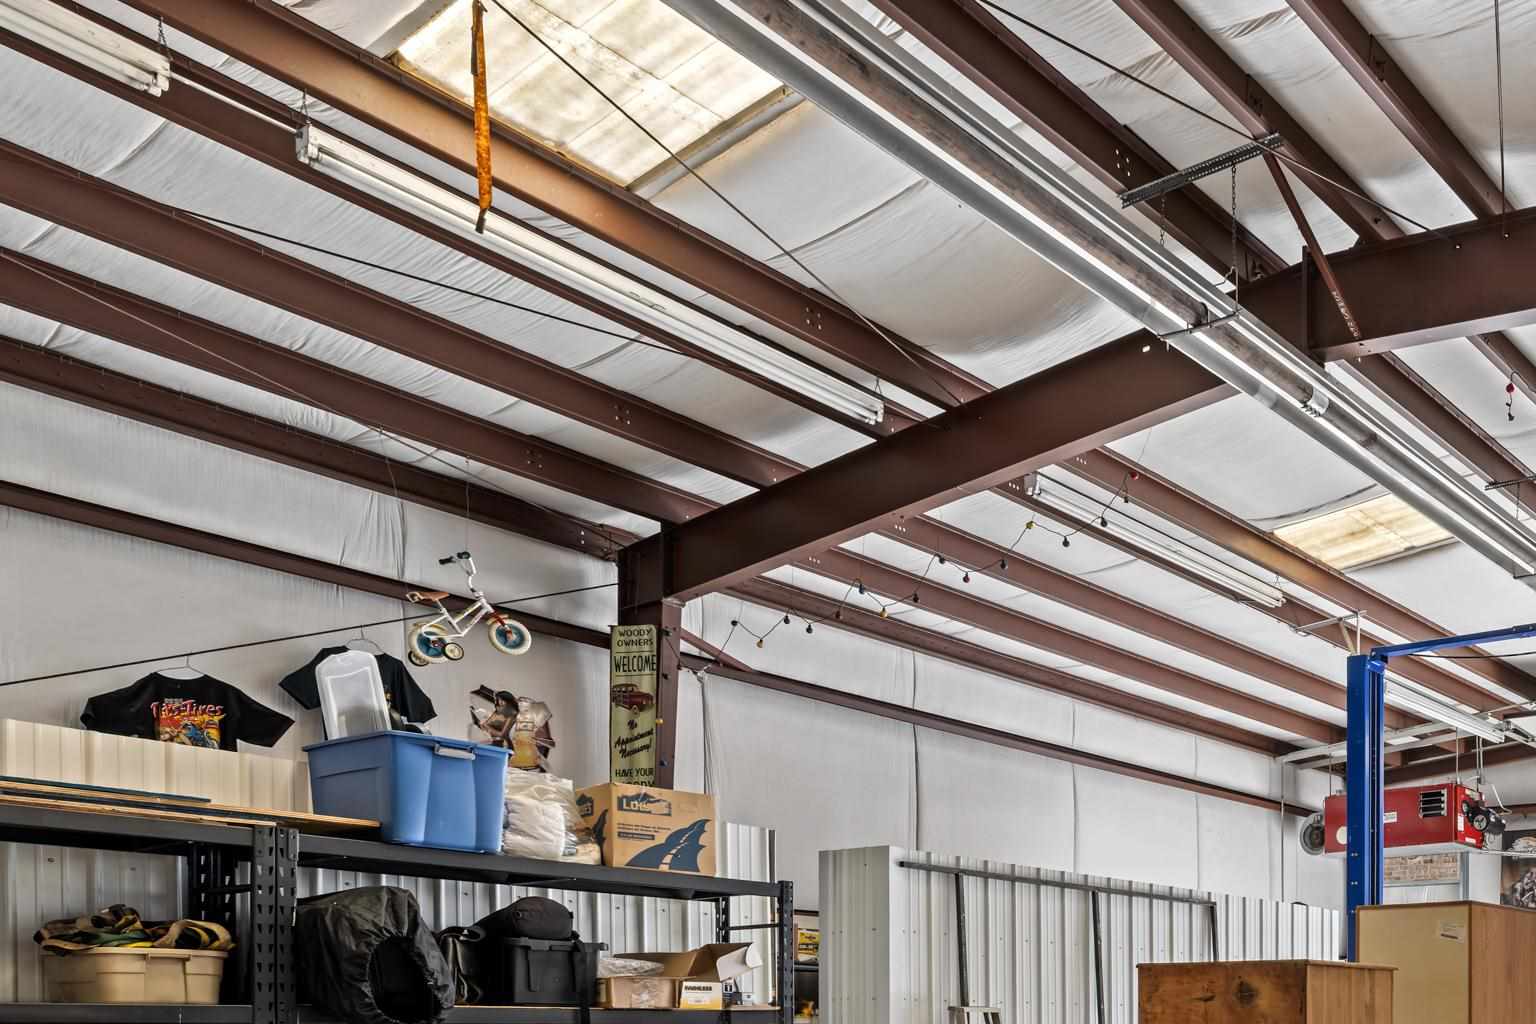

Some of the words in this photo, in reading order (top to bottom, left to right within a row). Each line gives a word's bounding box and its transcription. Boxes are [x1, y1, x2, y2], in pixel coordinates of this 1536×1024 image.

[617, 628, 653, 637] WOODY
[616, 639, 654, 648] OWNERS
[614, 654, 657, 673] WELCOME
[615, 768, 633, 777] HAVE
[634, 767, 654, 776] YOUR
